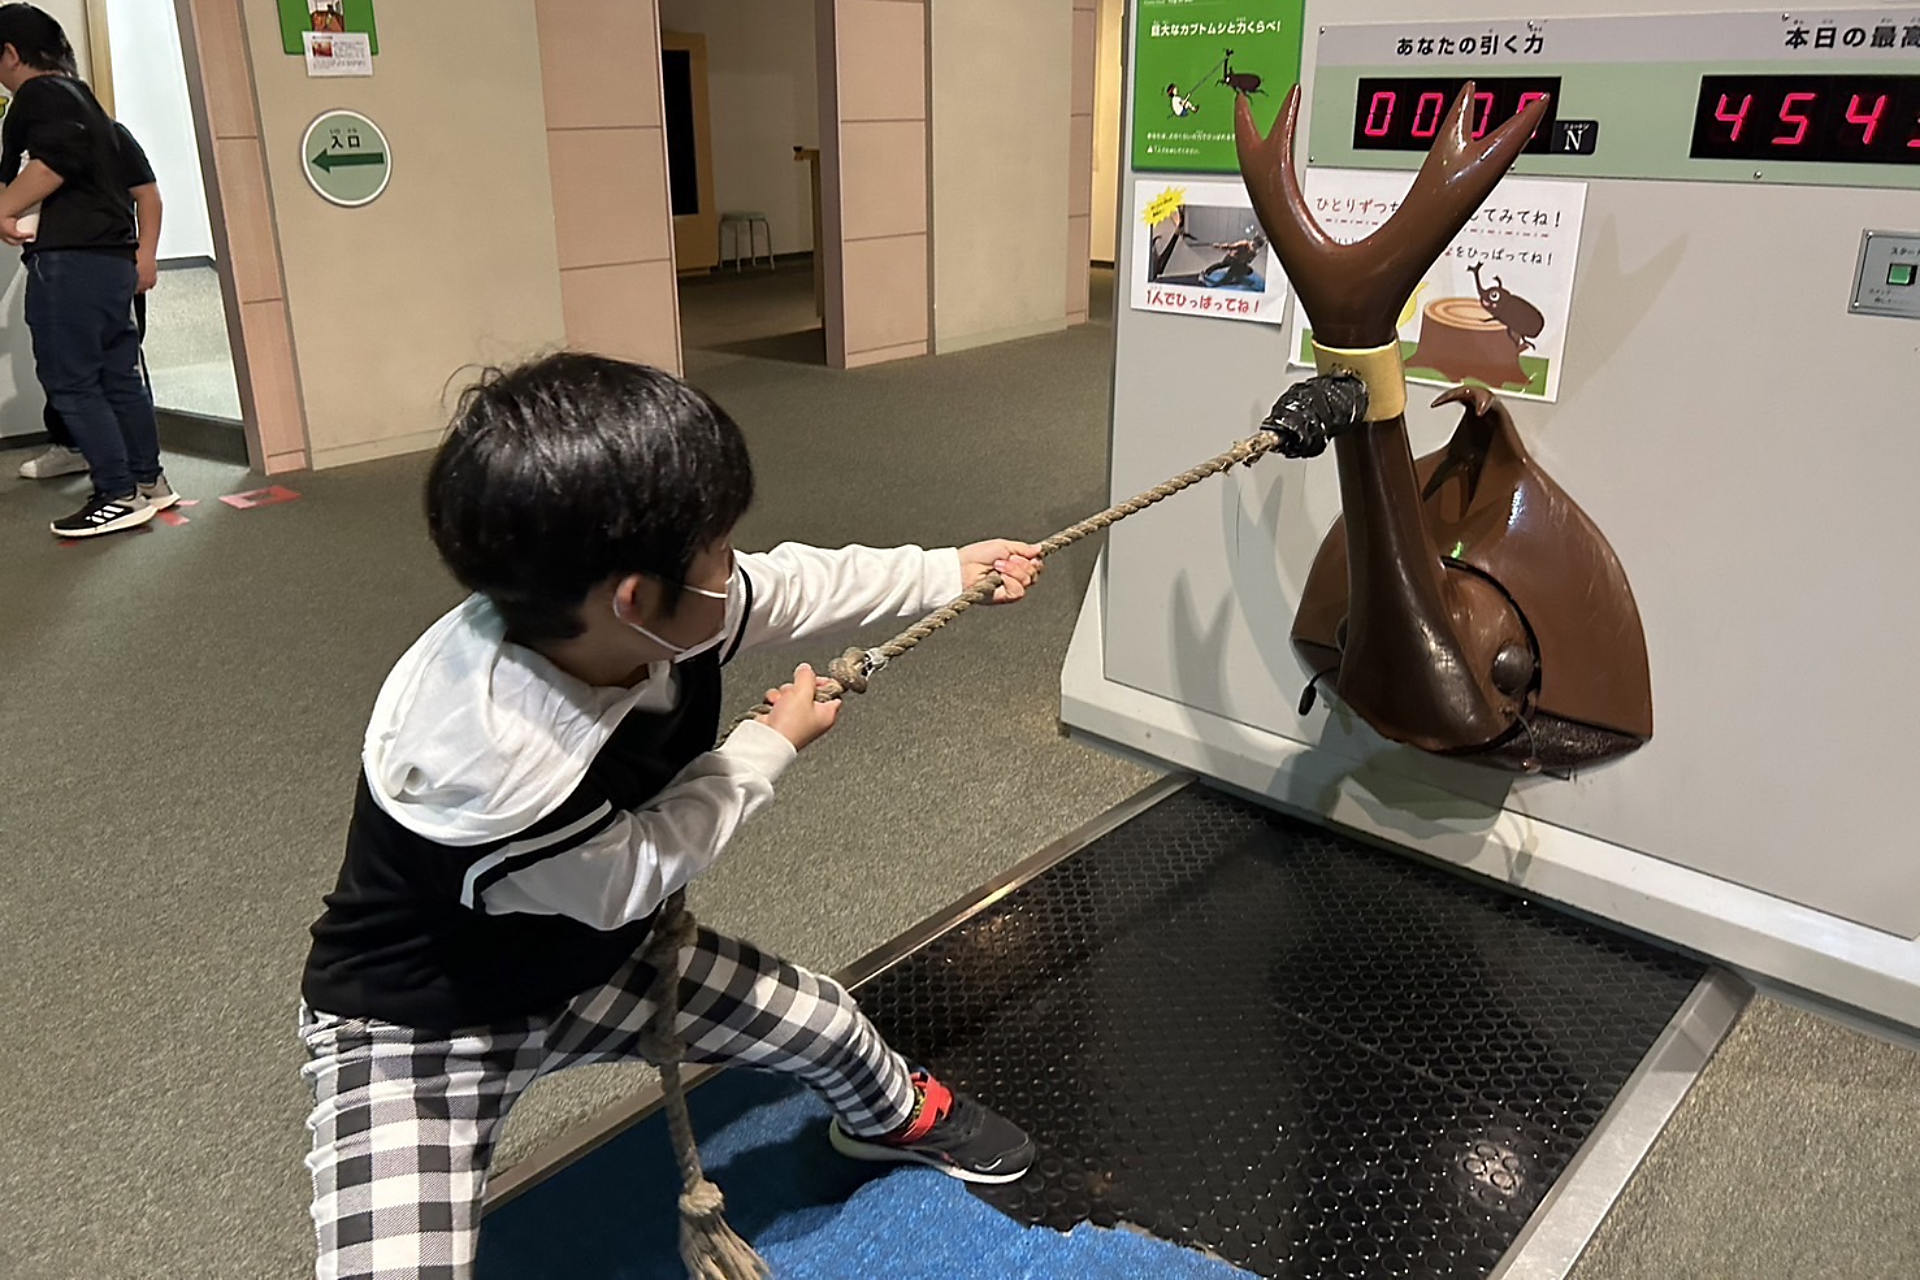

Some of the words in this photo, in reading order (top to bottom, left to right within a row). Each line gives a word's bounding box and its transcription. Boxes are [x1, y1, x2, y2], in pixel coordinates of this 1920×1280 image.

[1397, 34, 1544, 55] あなたの引く力
[331, 135, 360, 149] 入口
[1564, 130, 1583, 151] N
